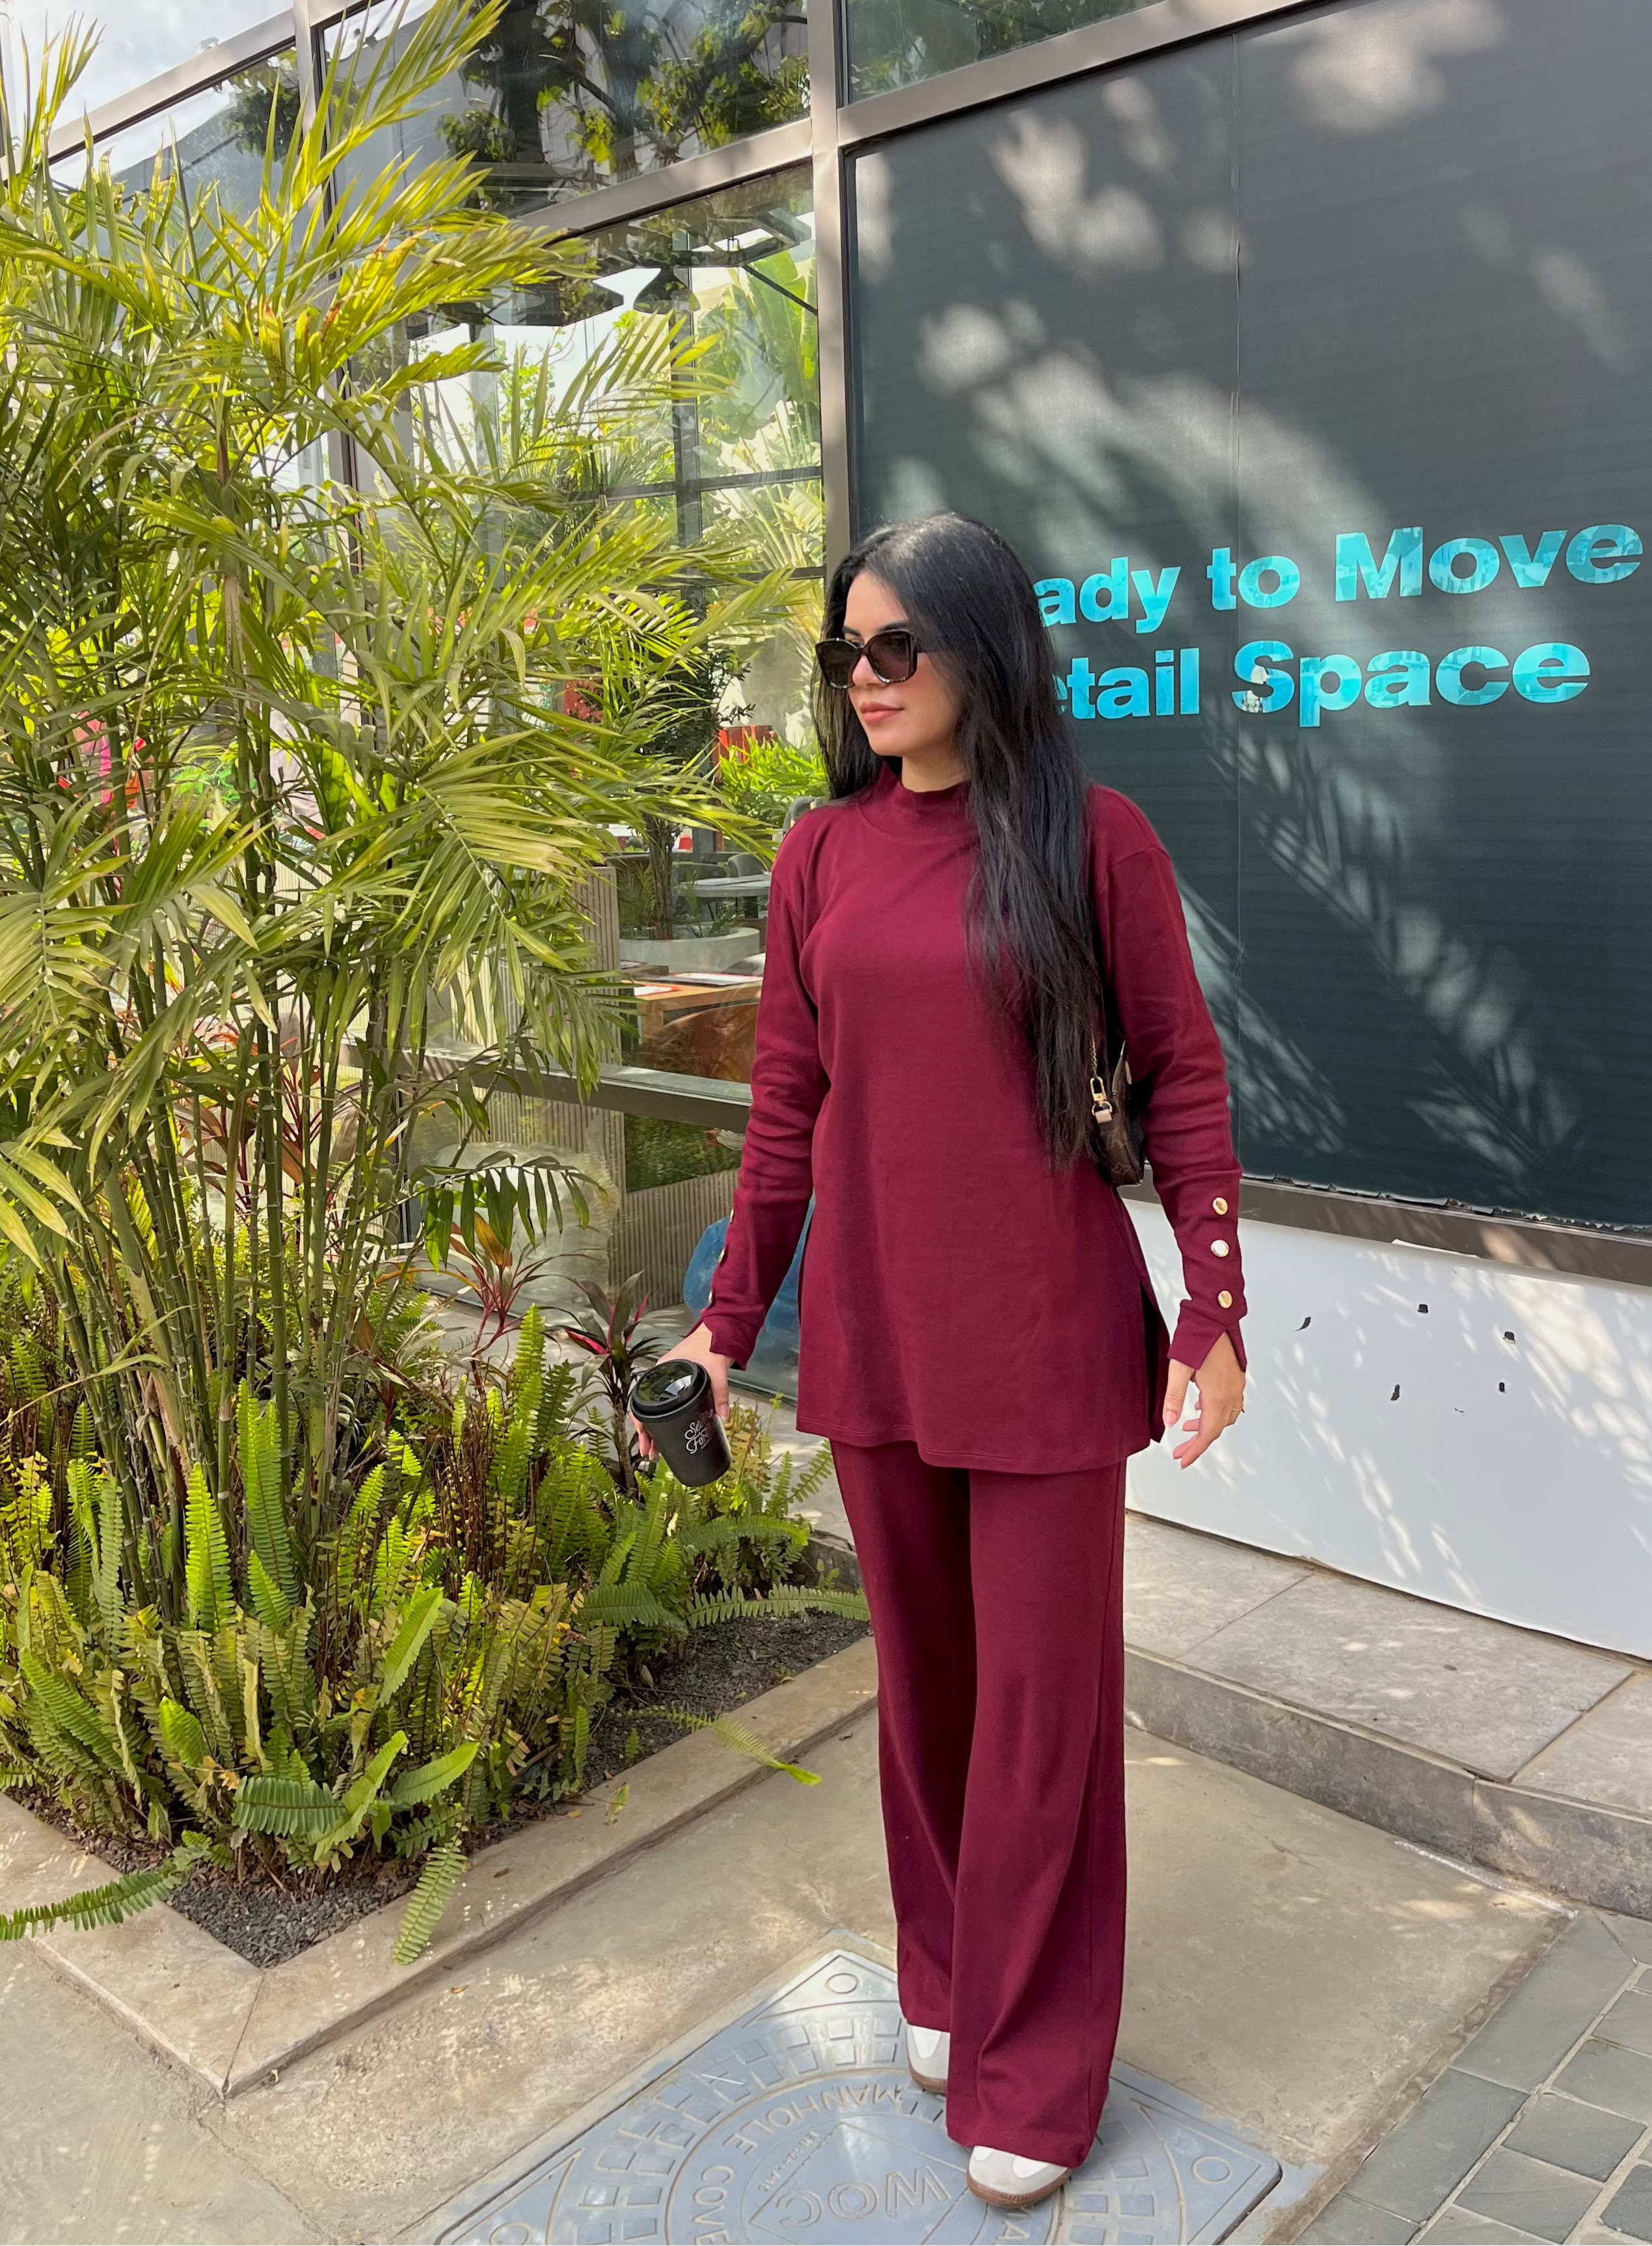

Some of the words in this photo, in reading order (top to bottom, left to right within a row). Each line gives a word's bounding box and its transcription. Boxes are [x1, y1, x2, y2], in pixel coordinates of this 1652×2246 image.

[1033, 556, 1181, 634] ady
[1207, 547, 1301, 610] to
[1336, 524, 1643, 602] Move
[1051, 648, 1200, 720] tail
[1231, 640, 1590, 728] Space
[722, 2084, 902, 2156] MANHOLE
[691, 2165, 735, 2245] COVE
[776, 2166, 952, 2229] WOC
